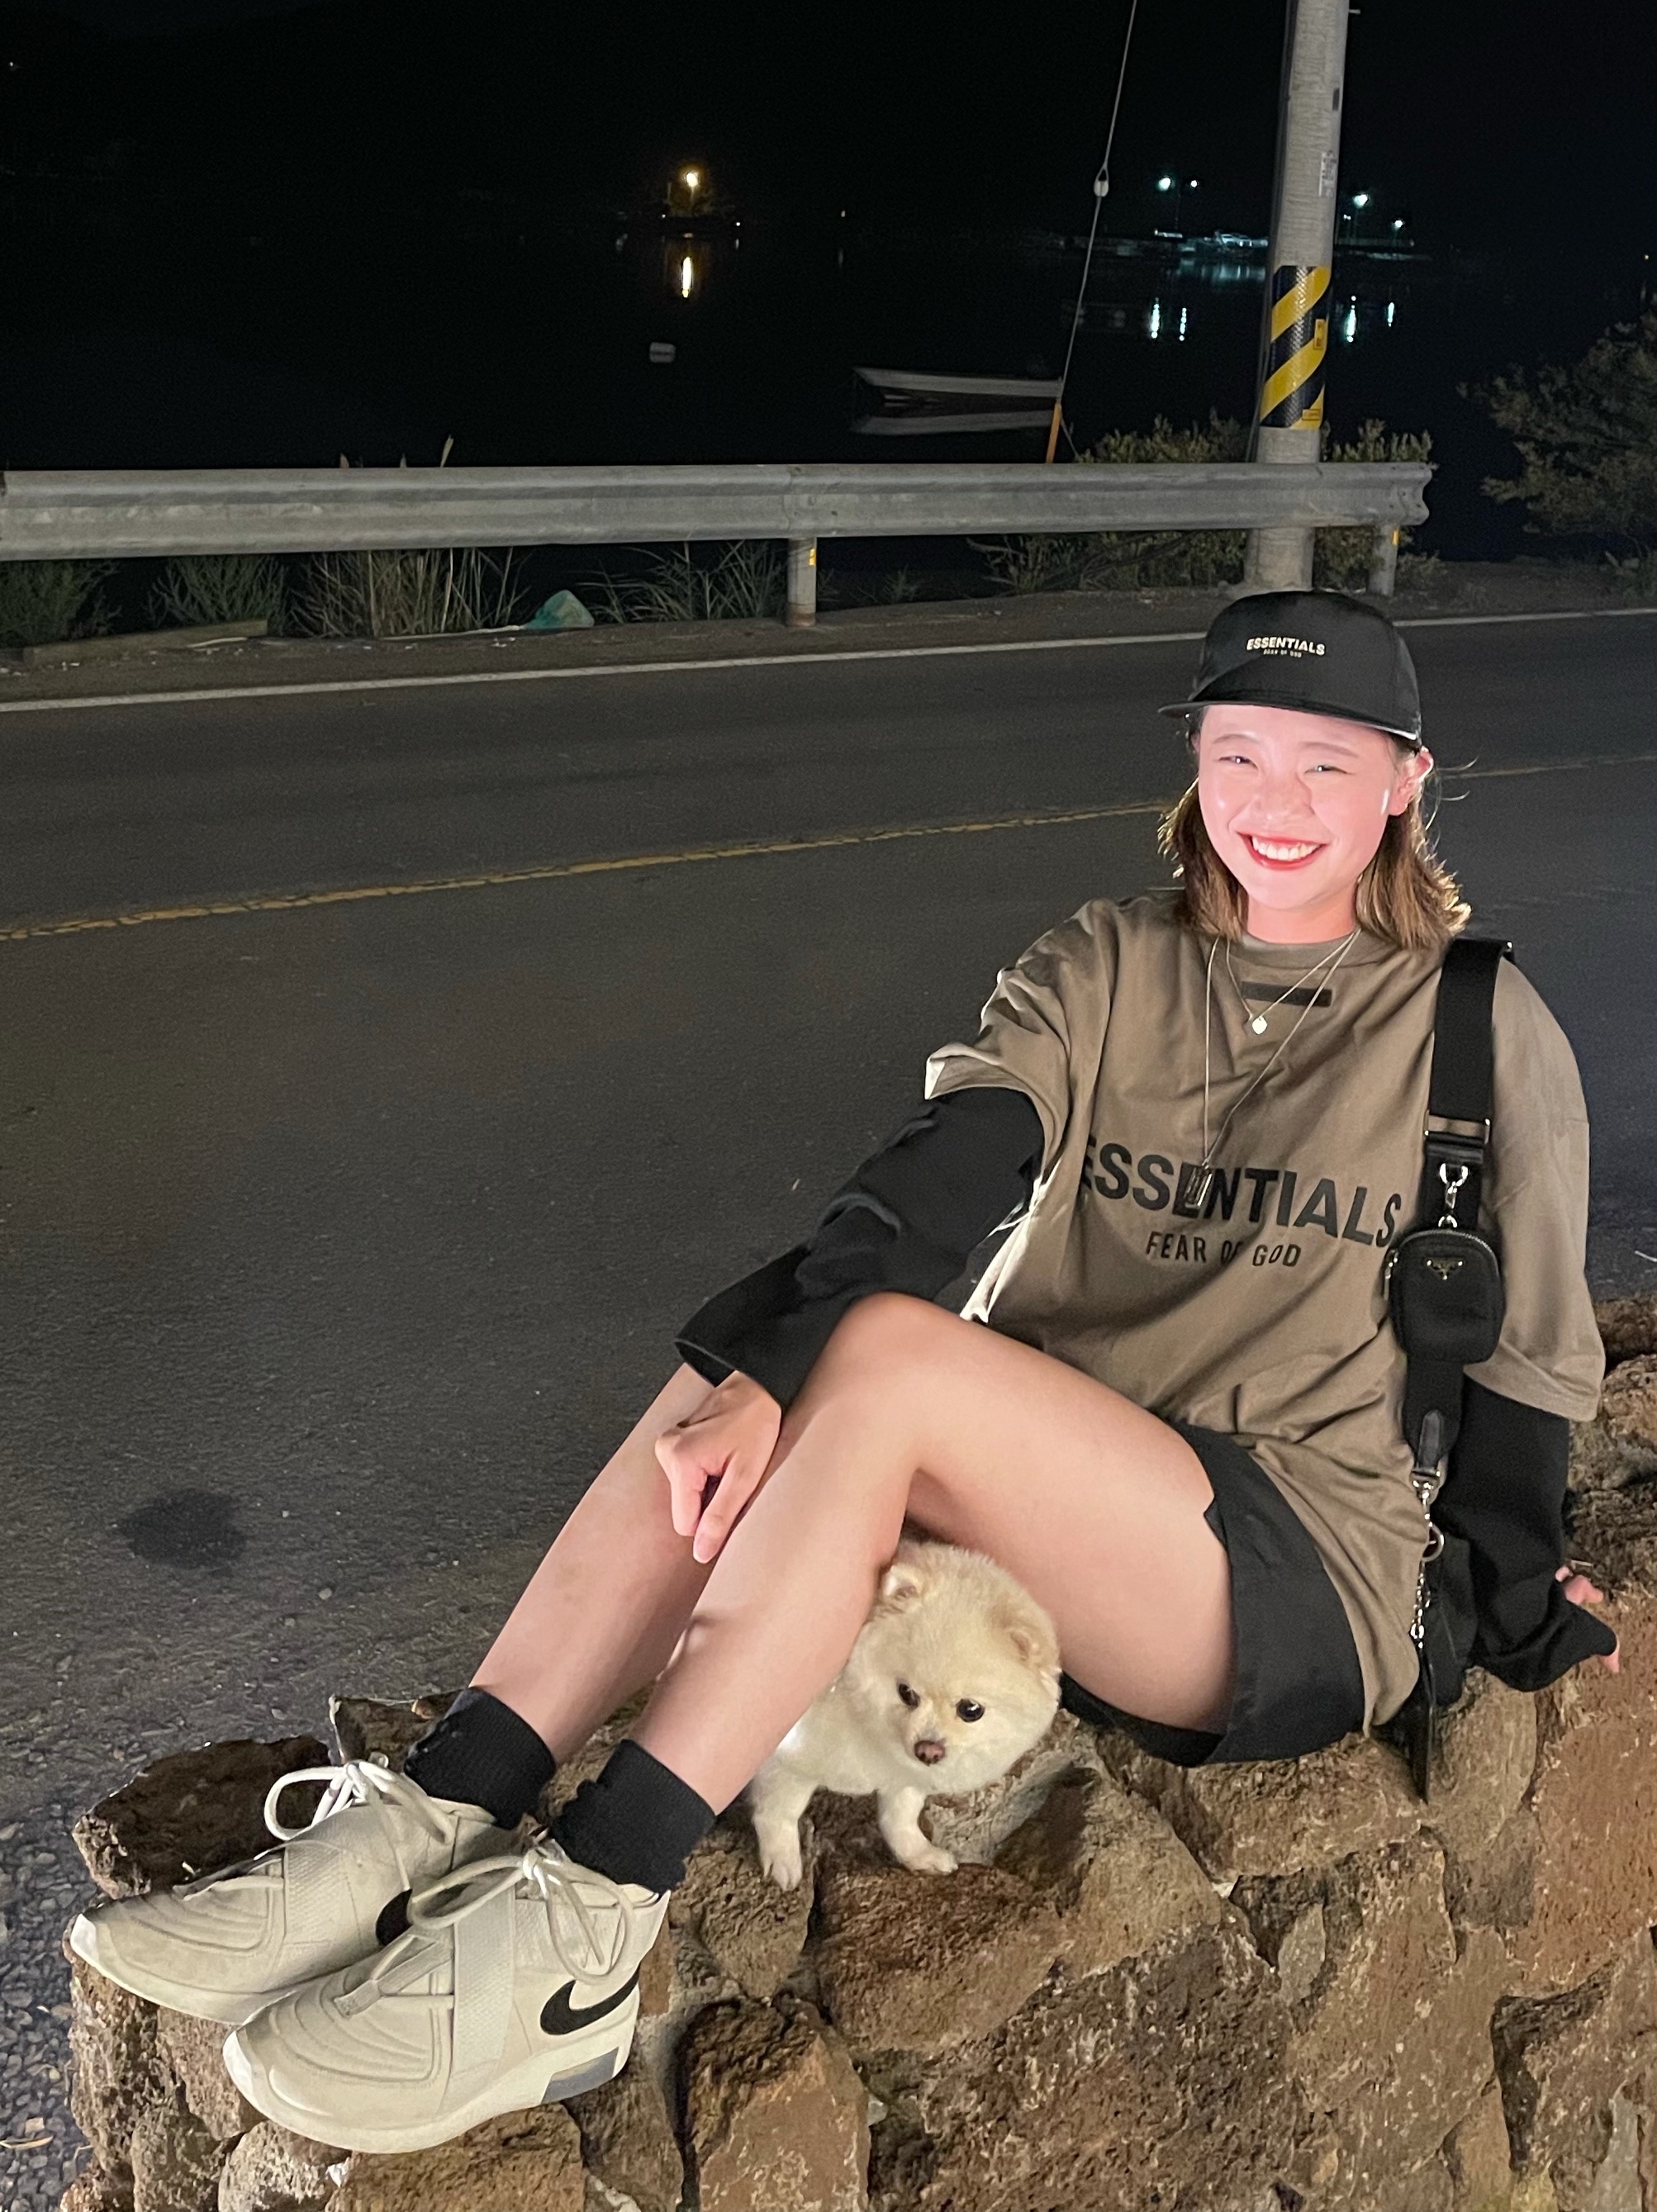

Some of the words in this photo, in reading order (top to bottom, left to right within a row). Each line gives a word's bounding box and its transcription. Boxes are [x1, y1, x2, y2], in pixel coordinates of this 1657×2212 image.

[1246, 637, 1325, 656] ESSENTIALS
[1146, 1231, 1207, 1263] FEAR
[1252, 1243, 1302, 1267] GOD
